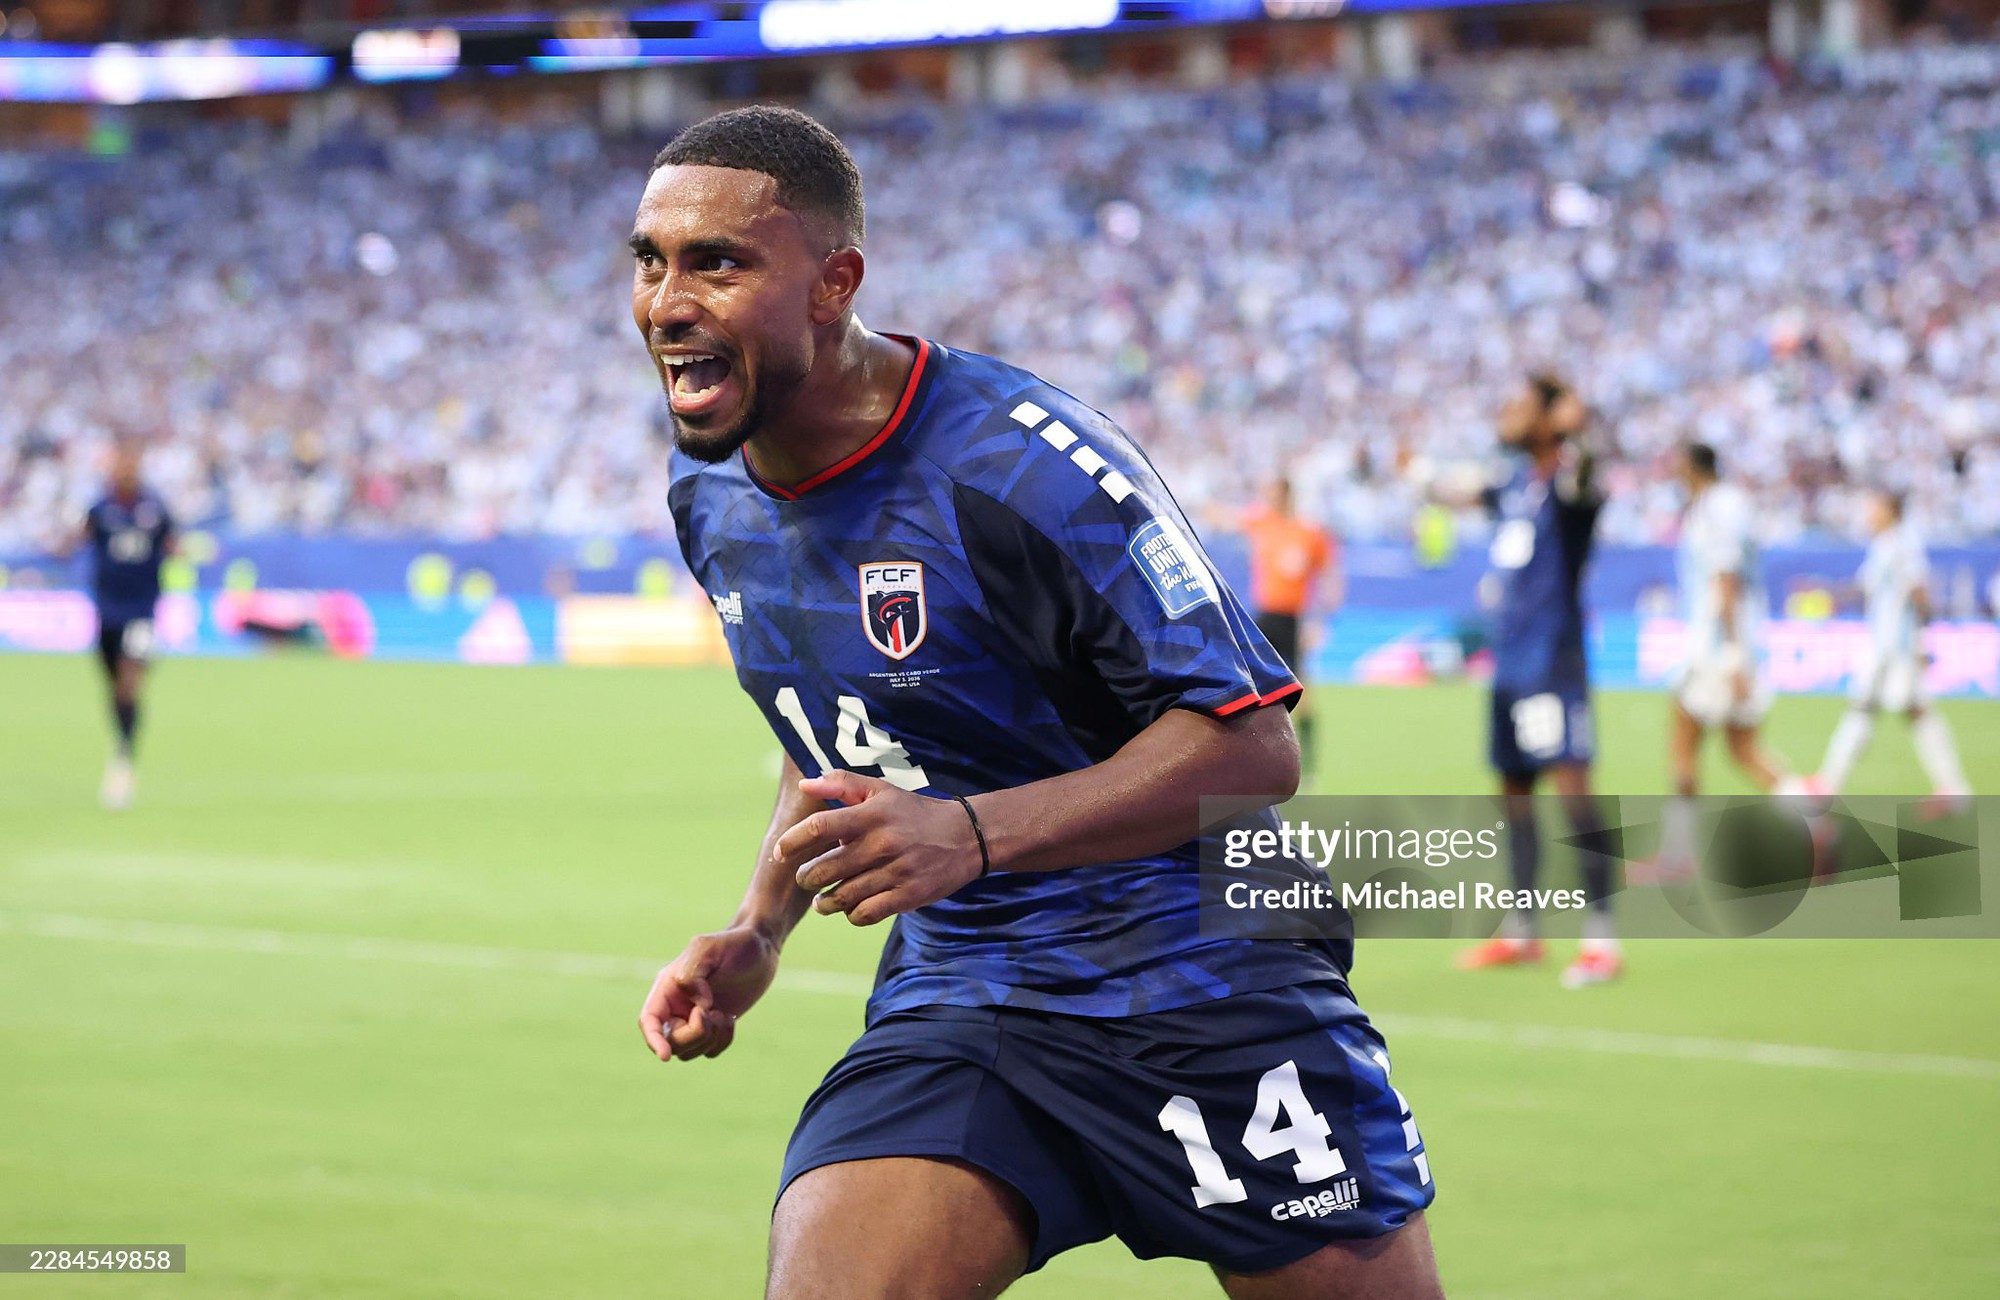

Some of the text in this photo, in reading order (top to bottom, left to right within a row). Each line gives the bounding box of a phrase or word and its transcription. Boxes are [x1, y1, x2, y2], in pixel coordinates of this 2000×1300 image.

[866, 569, 916, 584] FCF
[1160, 573, 1182, 591] the
[712, 591, 743, 617] apelli
[775, 687, 930, 792] 14
[1157, 1059, 1347, 1208] 14
[1271, 1177, 1359, 1221] capelli
[1317, 1199, 1360, 1218] SPORT
